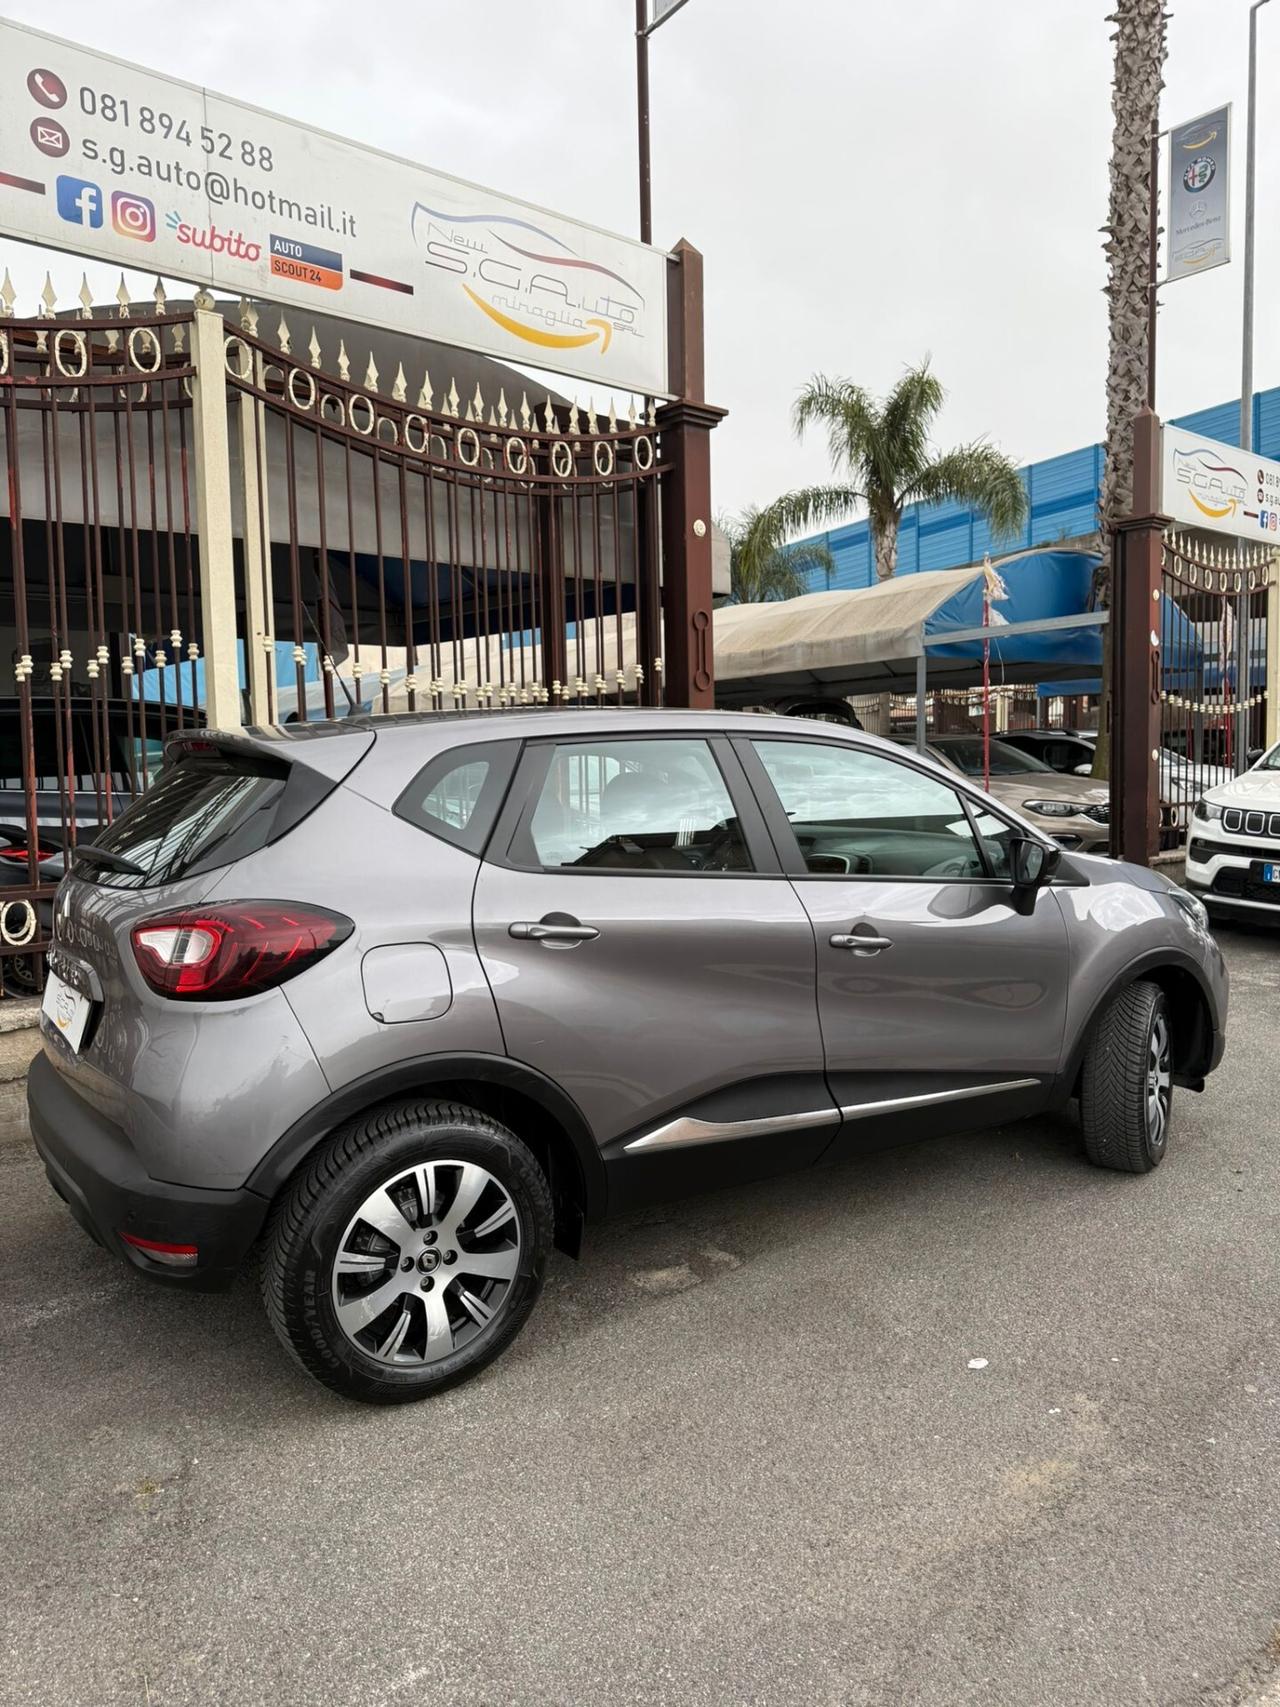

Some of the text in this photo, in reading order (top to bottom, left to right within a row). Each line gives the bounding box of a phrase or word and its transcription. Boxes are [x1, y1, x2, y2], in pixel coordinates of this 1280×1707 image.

[79, 86, 274, 172] 081 894 52 88
[82, 137, 357, 238] s.g.auto@hotmail.it
[176, 222, 262, 262] subito
[274, 242, 303, 257] AUTO
[427, 222, 489, 254] New
[274, 259, 322, 283] SCOUT 24
[491, 294, 587, 330] miraglia
